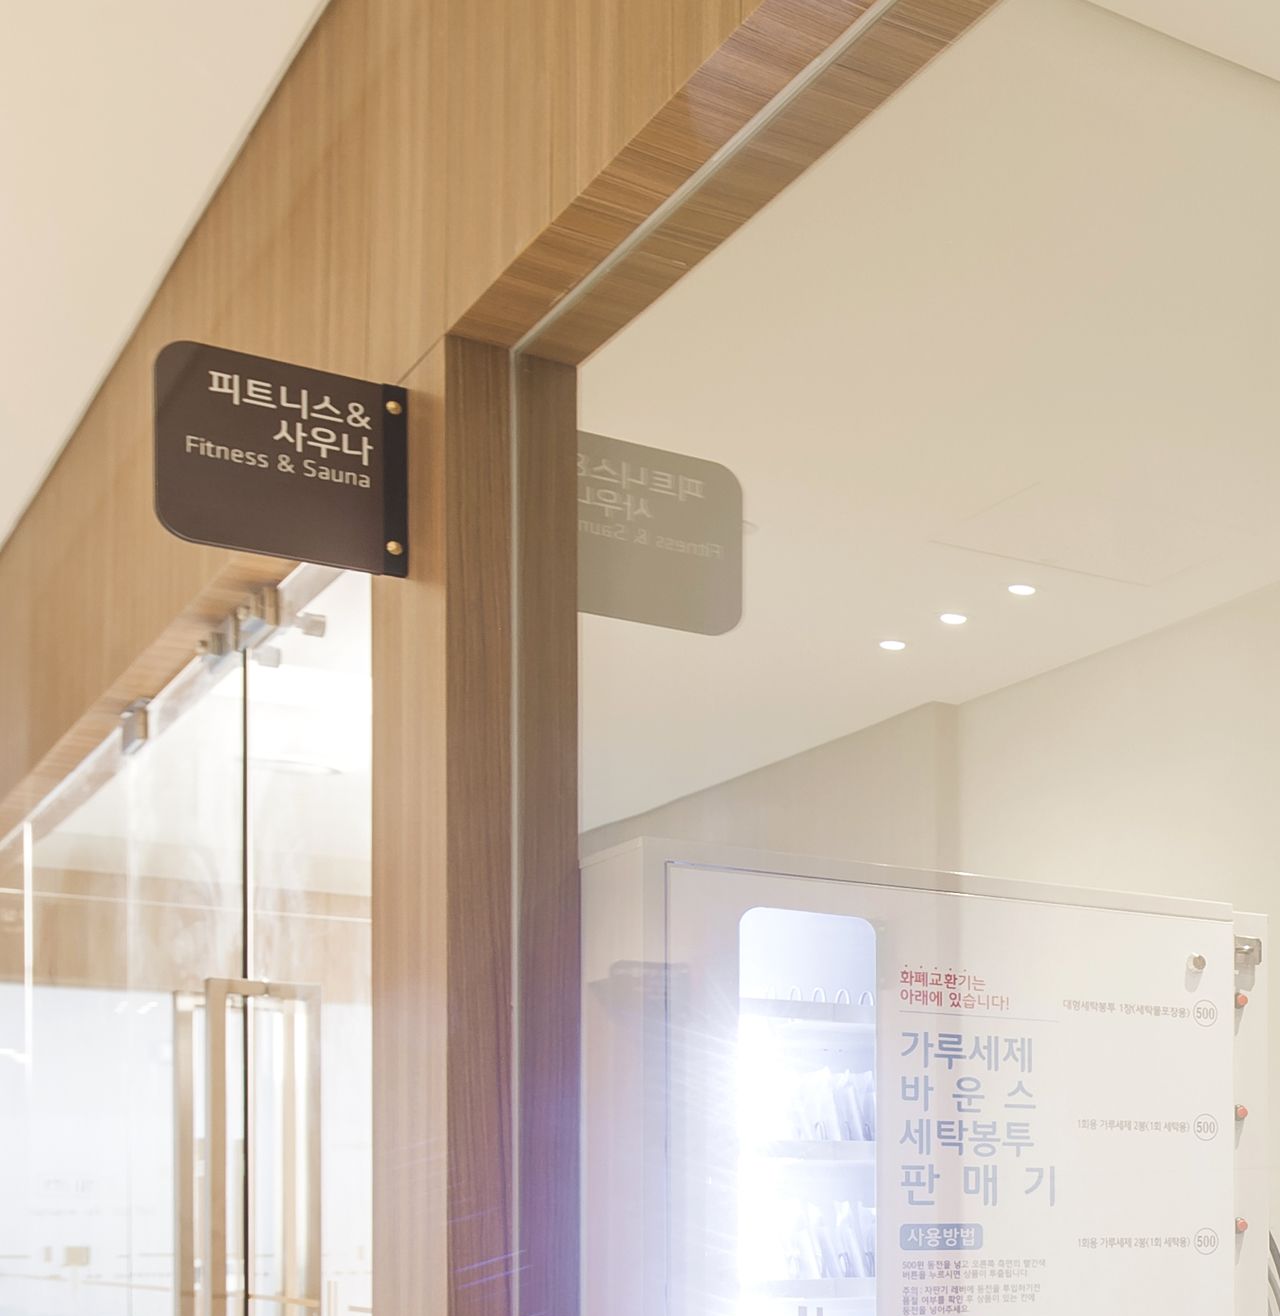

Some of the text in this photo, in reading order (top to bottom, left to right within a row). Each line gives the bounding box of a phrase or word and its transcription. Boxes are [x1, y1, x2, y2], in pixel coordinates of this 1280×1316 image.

[208, 370, 372, 430] 피트니스&
[273, 420, 374, 466] 사우나
[185, 435, 371, 488] Fitness & Sauna
[900, 969, 987, 992] 화폐교환기는
[900, 989, 1010, 1011] 아래에 있습니다!
[1196, 1007, 1215, 1021] 500
[901, 1031, 1033, 1072] 가루세제
[900, 1119, 1034, 1157] 세탁봉투
[1196, 1120, 1216, 1136] 500
[907, 1227, 976, 1248] 사용방법
[1197, 1234, 1216, 1249] 500
